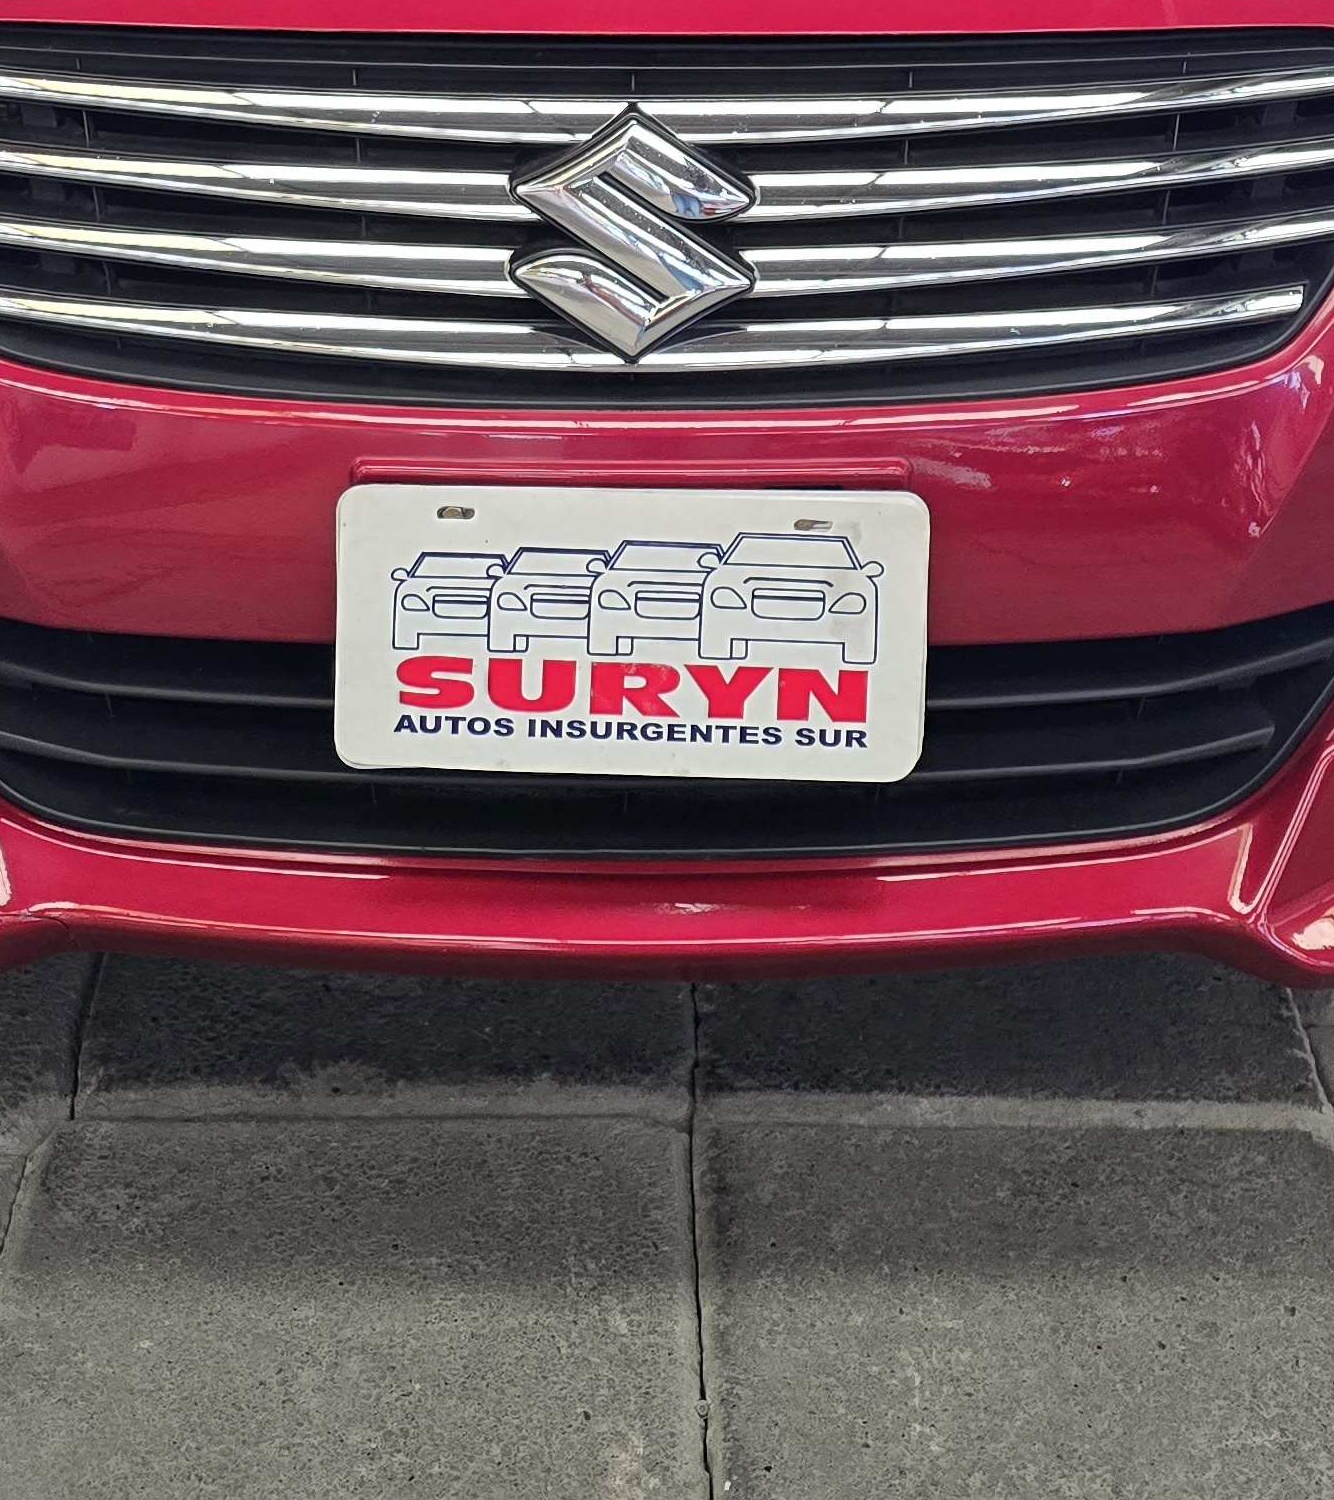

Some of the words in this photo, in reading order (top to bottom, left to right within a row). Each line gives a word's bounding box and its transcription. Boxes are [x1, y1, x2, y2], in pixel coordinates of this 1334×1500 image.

[396, 655, 869, 723] SURYN
[393, 714, 515, 737] AUTOS
[527, 718, 784, 746] INSURGENTES
[794, 727, 869, 749] SUR
